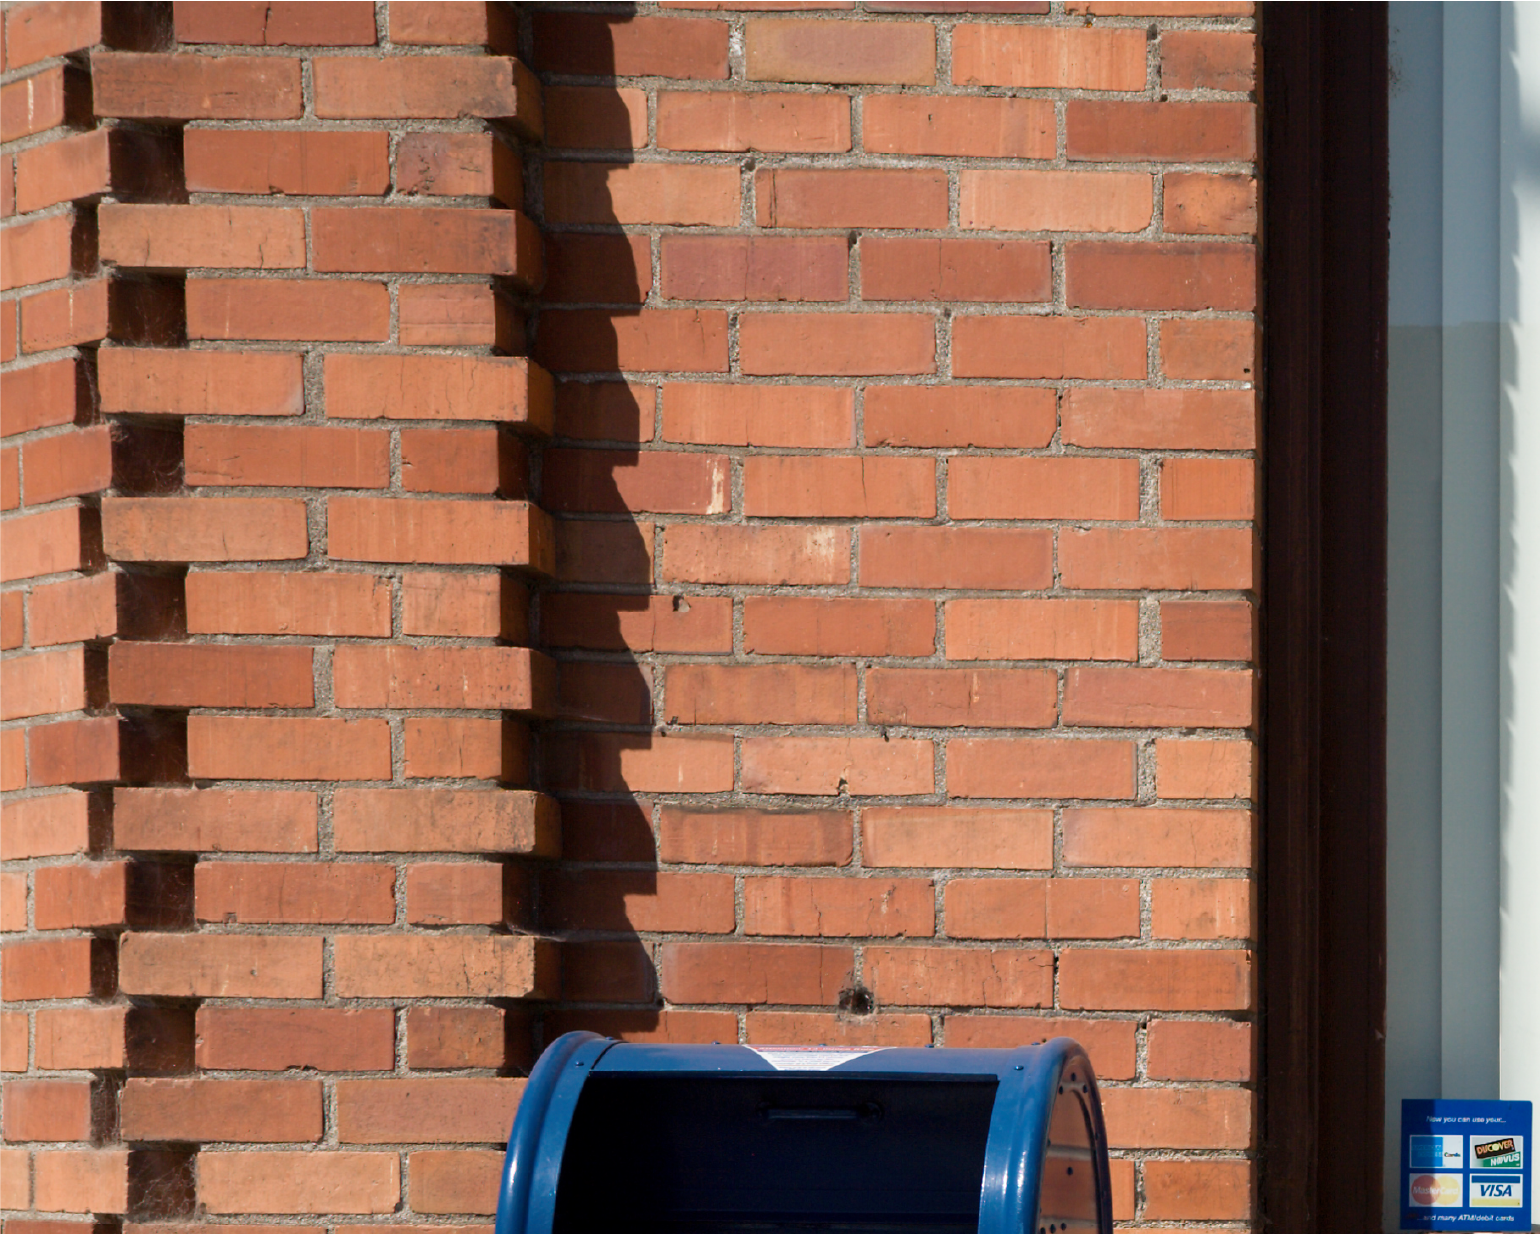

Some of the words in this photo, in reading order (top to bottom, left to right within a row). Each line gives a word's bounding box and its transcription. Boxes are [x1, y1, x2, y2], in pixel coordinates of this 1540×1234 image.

[1443, 1117, 1457, 1125] you
[1490, 1153, 1520, 1167] NOVUS
[1412, 1186, 1459, 1195] MasterCard
[1480, 1184, 1512, 1197] VISA
[1437, 1215, 1457, 1223] many
